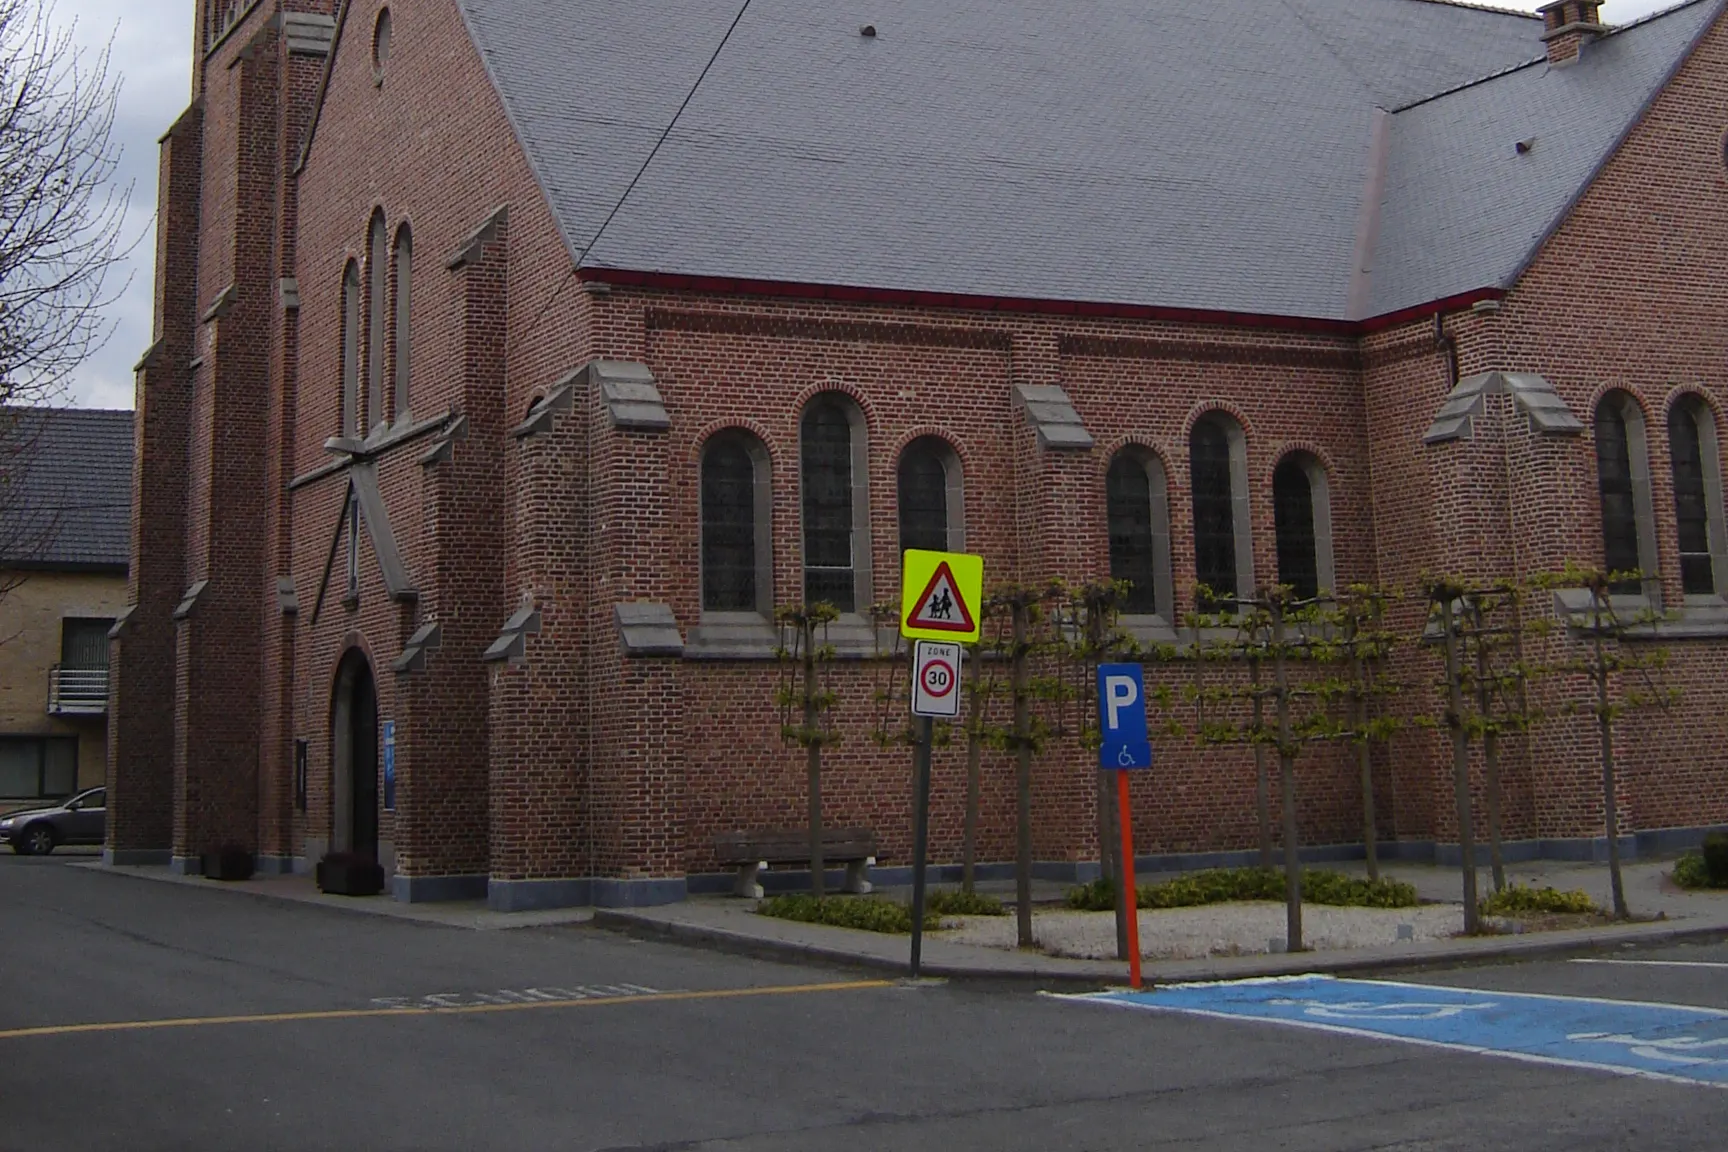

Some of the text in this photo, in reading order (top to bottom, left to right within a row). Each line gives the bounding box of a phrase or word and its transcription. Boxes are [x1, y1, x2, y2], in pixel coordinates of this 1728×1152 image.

[927, 647, 951, 656] ZONE
[928, 671, 947, 685] 30
[1106, 676, 1137, 729] P
